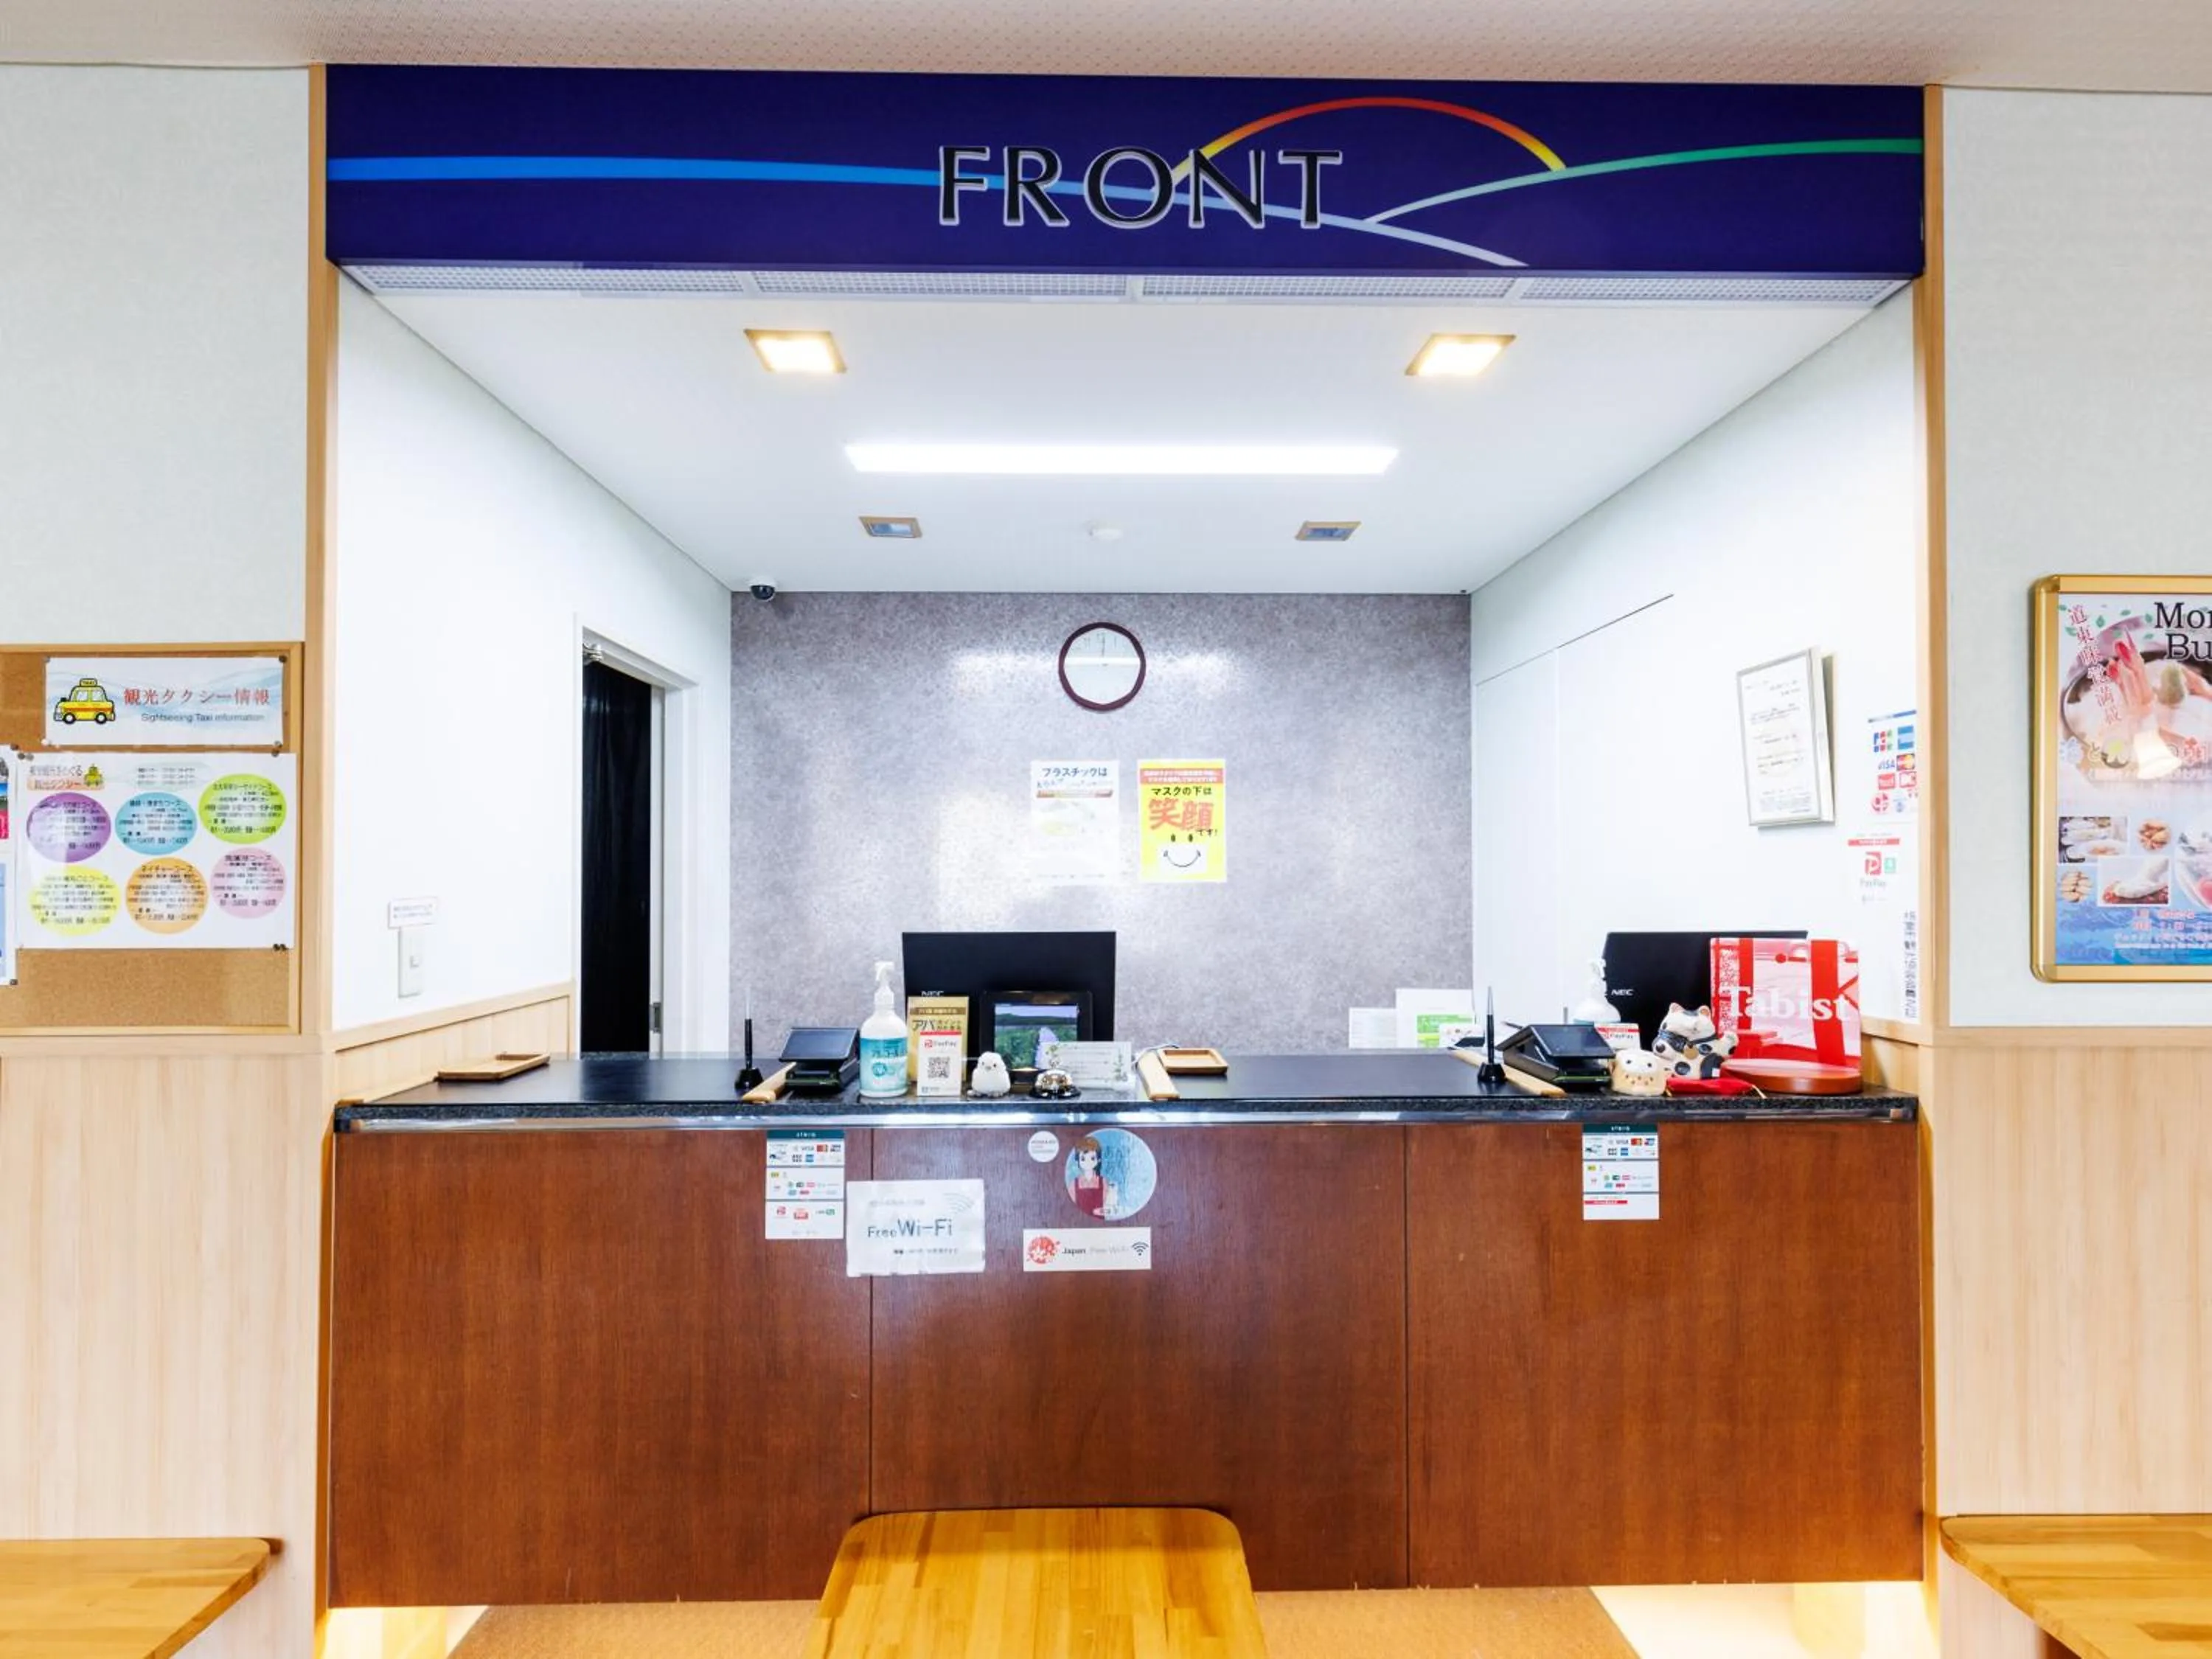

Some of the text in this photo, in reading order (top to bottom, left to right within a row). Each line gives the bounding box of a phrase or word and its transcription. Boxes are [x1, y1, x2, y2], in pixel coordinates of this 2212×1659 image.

[939, 144, 1343, 229] FRONT
[123, 687, 271, 706] 観光タクシー情報
[141, 712, 193, 723] Sightseeing
[195, 712, 214, 722] Taxi
[1151, 785, 1213, 797] マスクの下は
[1148, 797, 1215, 831] 笑顔
[1611, 988, 1635, 996] NEC
[1719, 985, 1851, 1022] Tabist
[1062, 1248, 1086, 1257] Japan
